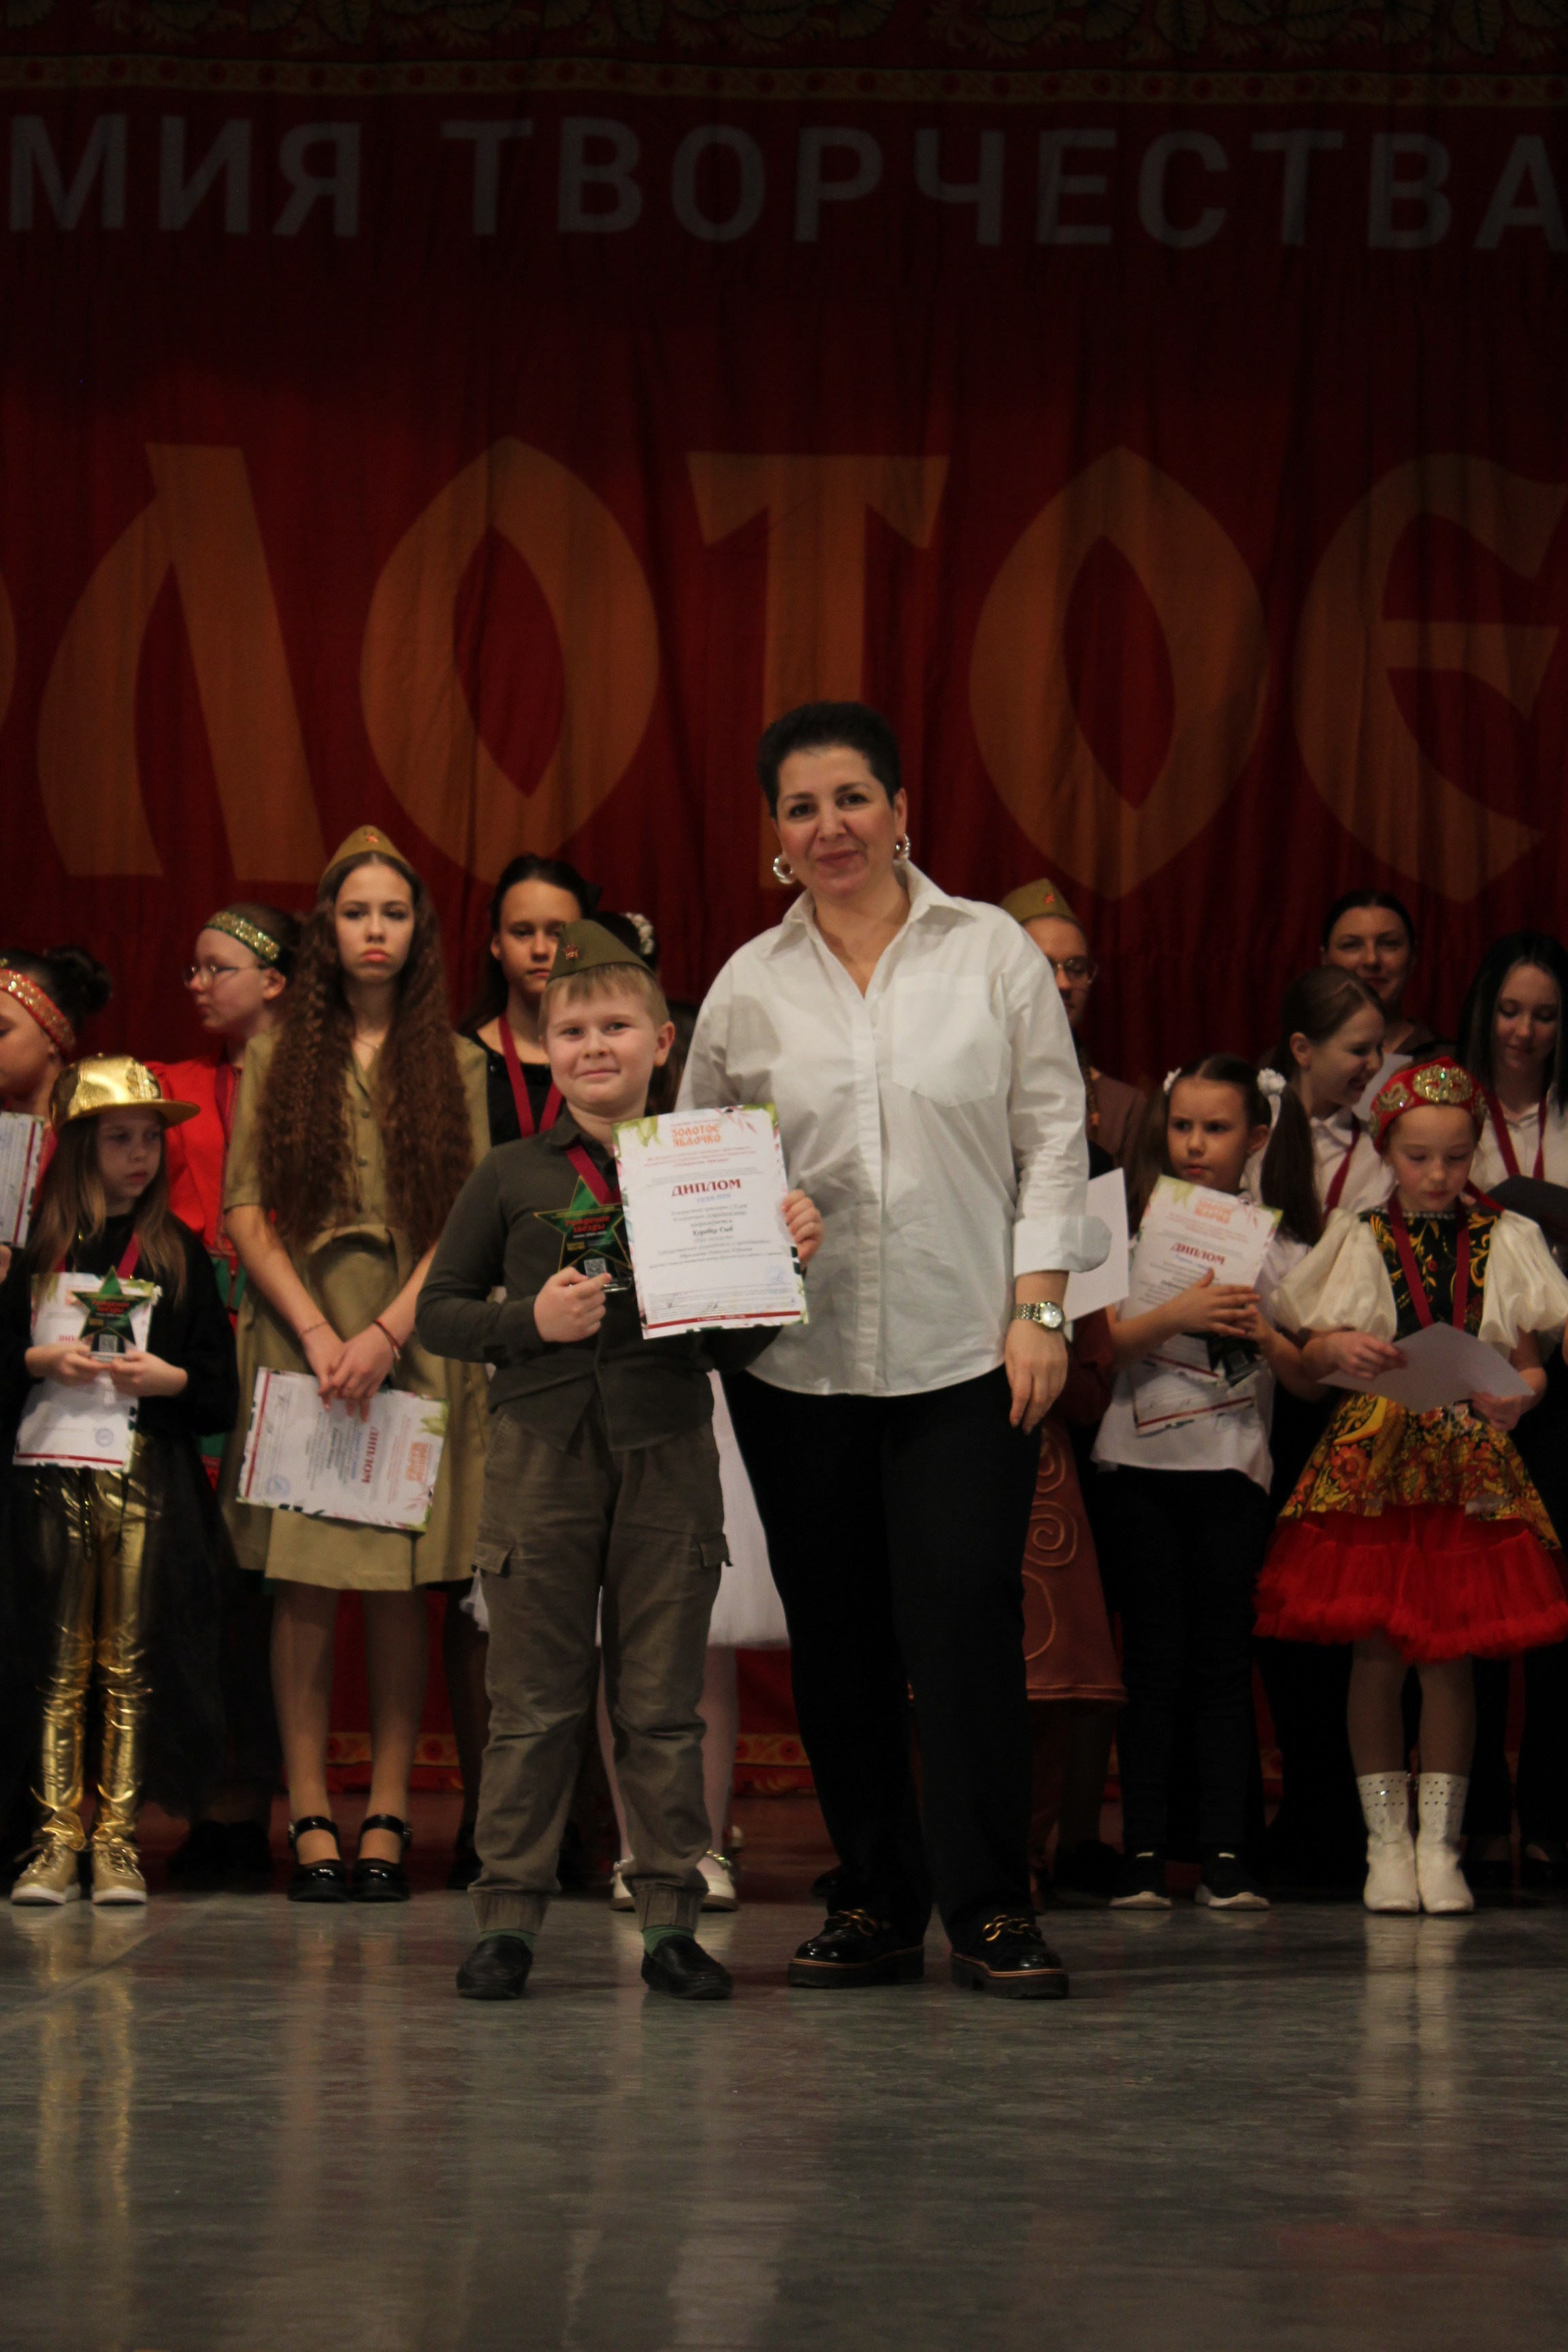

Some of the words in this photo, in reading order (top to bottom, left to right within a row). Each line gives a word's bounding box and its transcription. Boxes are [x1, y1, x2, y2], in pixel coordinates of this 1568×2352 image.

[9, 113, 362, 239] МИЯ
[439, 116, 1568, 252] ТВОРЧЕСТВА
[0, 436, 1568, 901] ЛОТОЕ
[672, 1124, 719, 1137] ЗОЛОТОЕ
[673, 1134, 721, 1148] ЯБЛОЧКО
[671, 1179, 741, 1198] ДИПЛОМ
